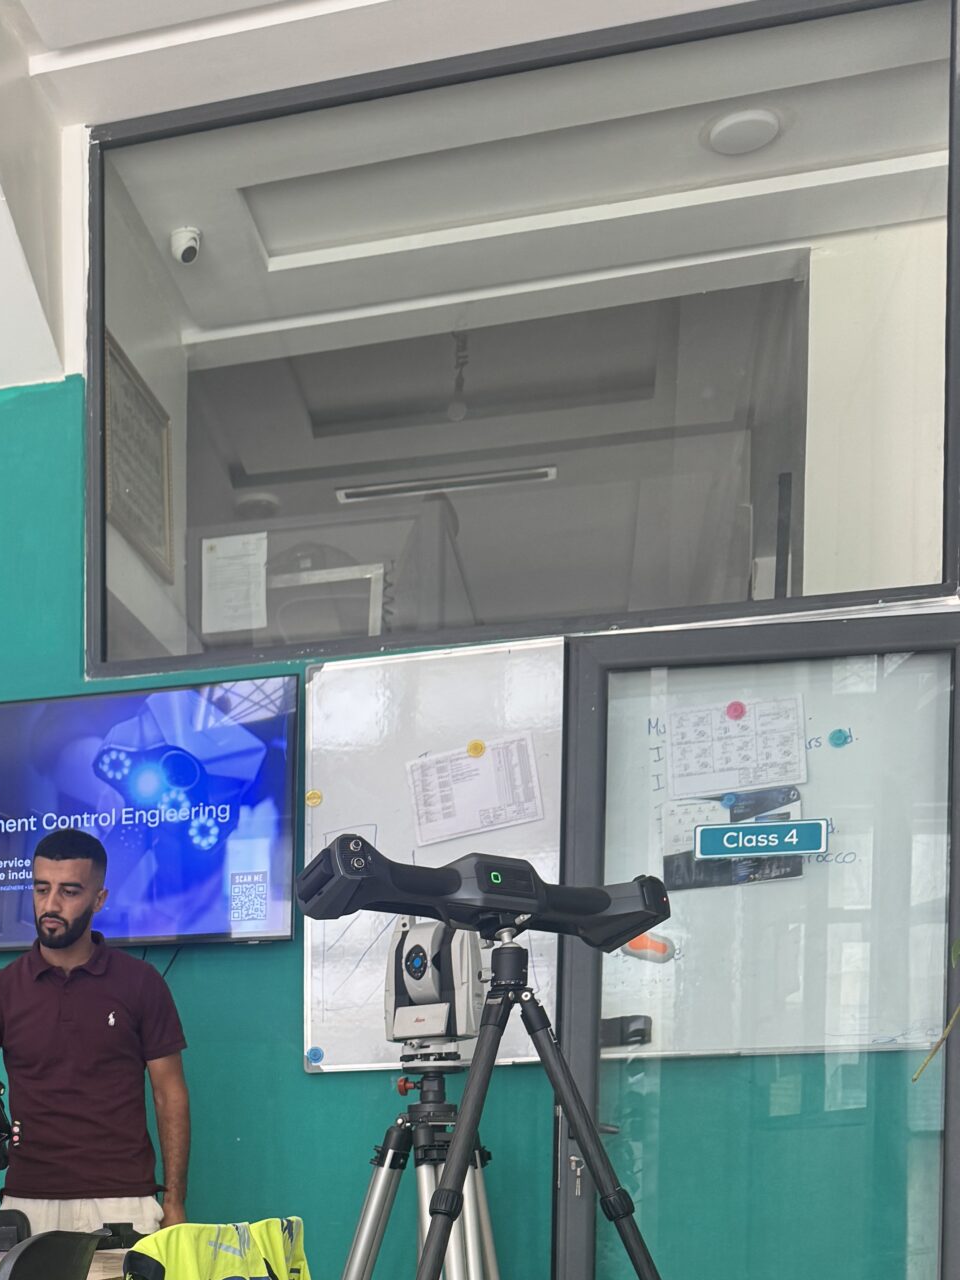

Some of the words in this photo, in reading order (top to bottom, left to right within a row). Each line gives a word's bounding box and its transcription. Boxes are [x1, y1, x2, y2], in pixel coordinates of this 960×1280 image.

[42, 808, 116, 831] Control
[722, 831, 779, 848] Class
[783, 829, 799, 846] 4
[8, 869, 33, 880] indu
[235, 873, 252, 883] SCAN
[253, 873, 264, 882] ME
